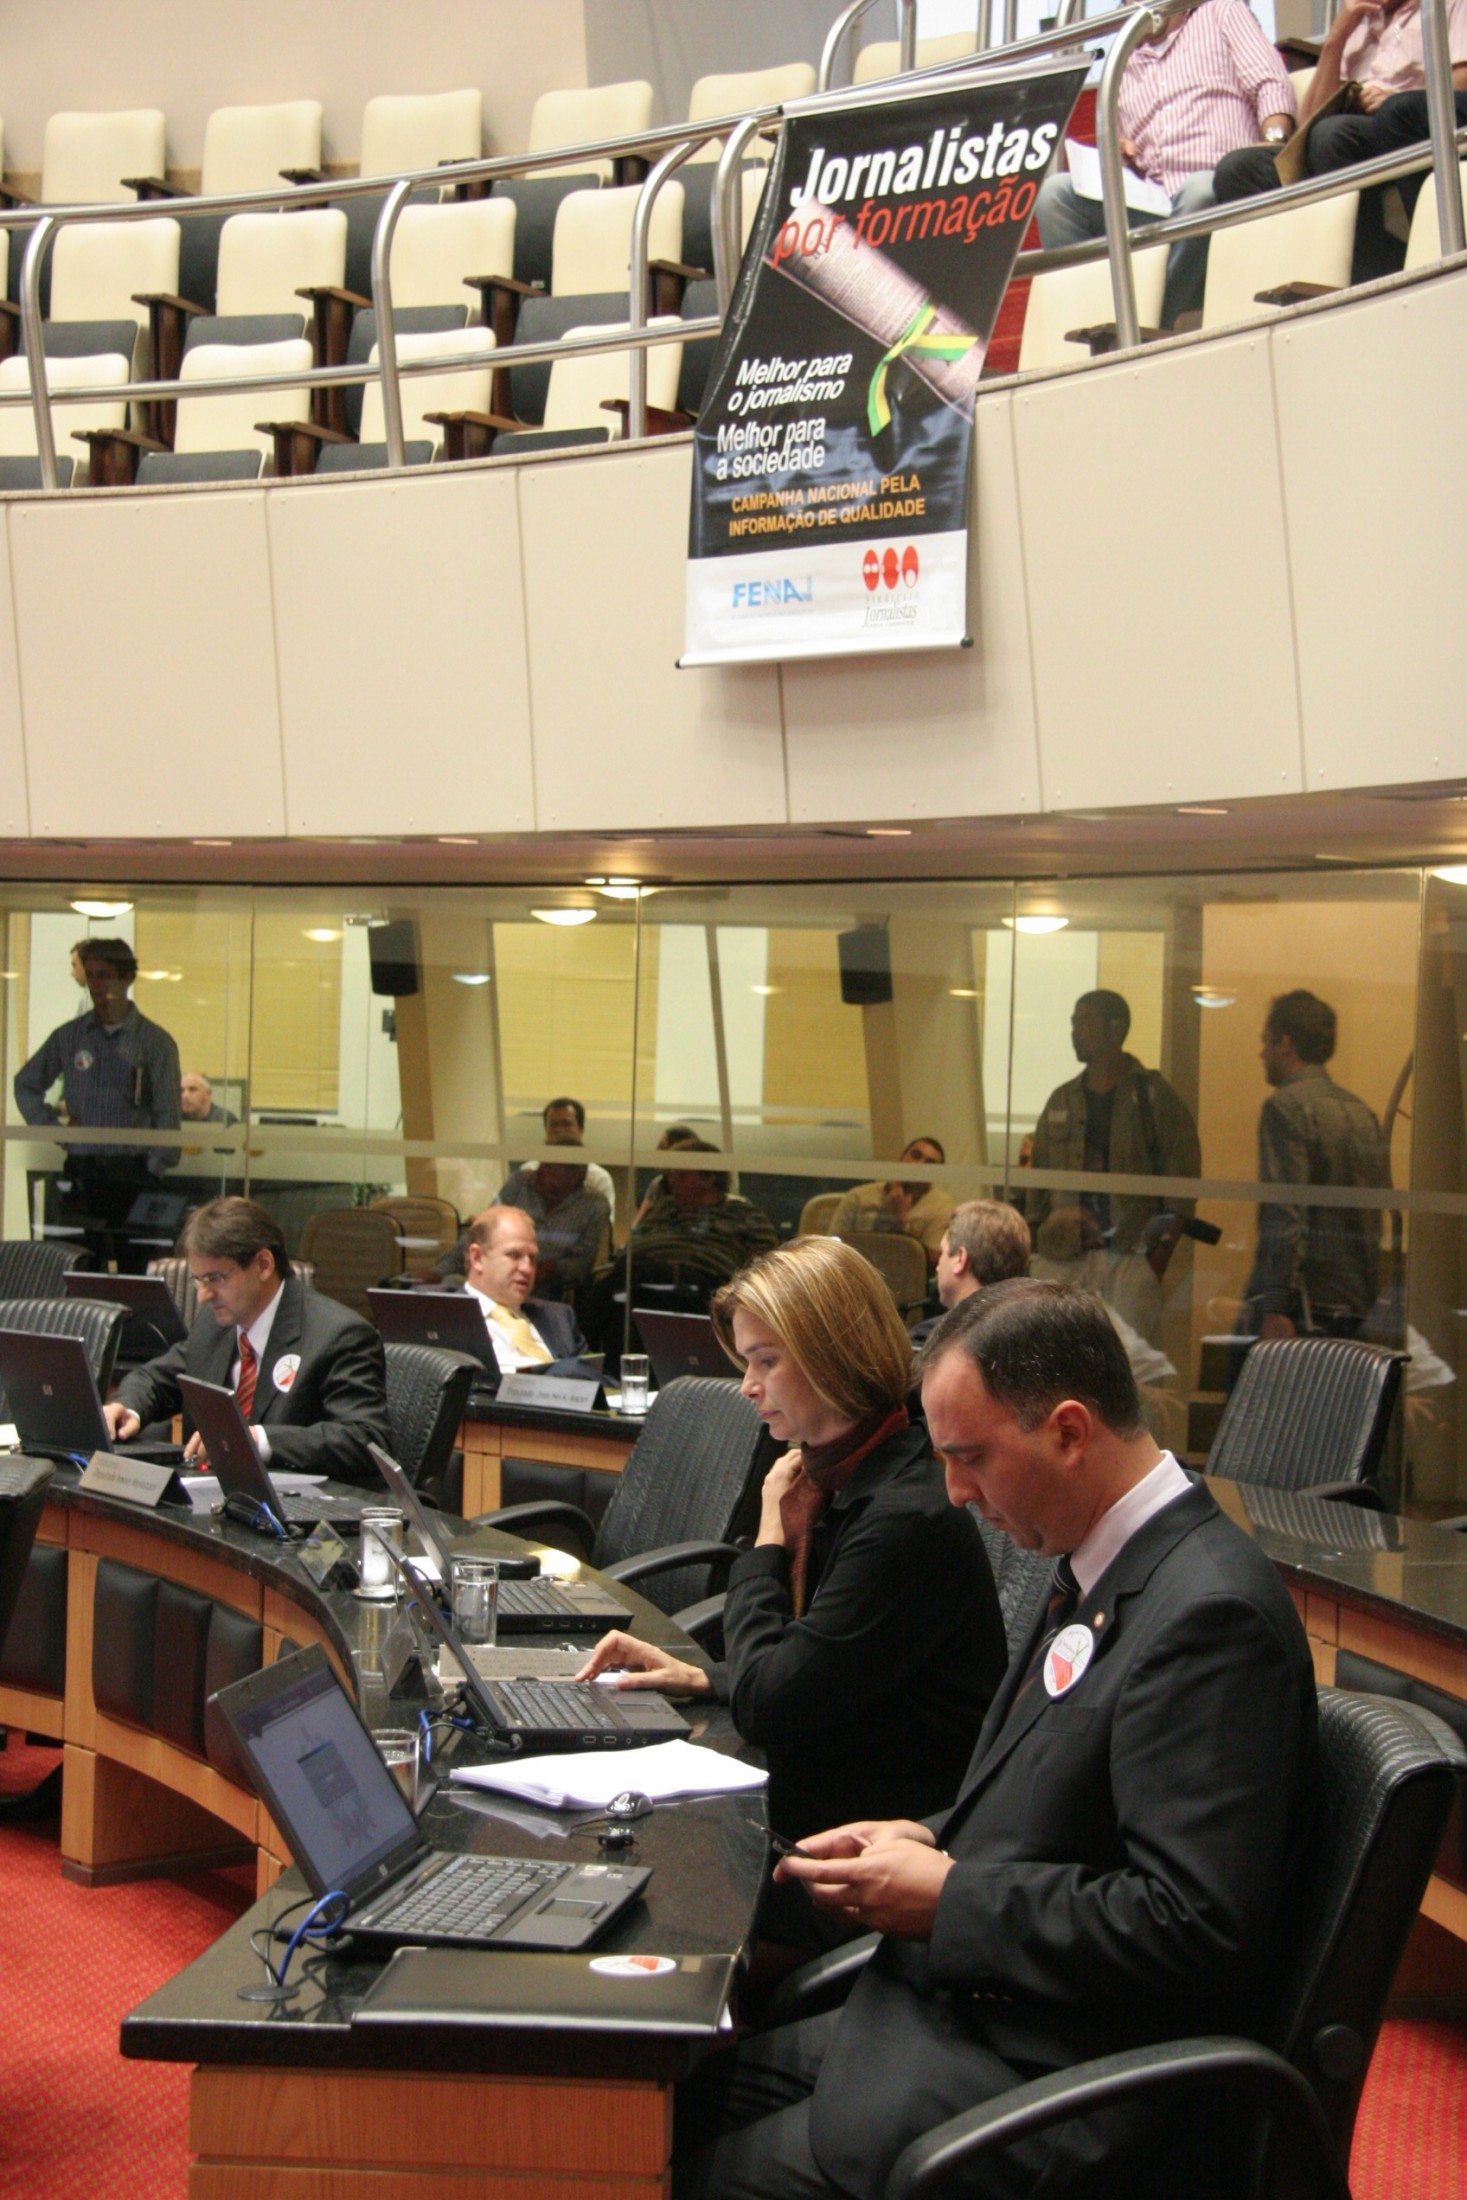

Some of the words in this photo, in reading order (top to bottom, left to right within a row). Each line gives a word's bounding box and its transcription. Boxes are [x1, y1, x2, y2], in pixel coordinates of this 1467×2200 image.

[790, 122, 1058, 208] Jornalistas
[771, 214, 846, 270] por
[854, 176, 1038, 249] formação
[736, 357, 807, 385] Melhor
[803, 354, 853, 388] para
[728, 392, 743, 411] o
[741, 376, 845, 415] jornalismo
[717, 423, 782, 453] Melhor
[785, 417, 826, 450] para
[716, 464, 728, 481] a
[732, 445, 826, 478] sociedade
[731, 489, 804, 513] CAMPANHA
[807, 482, 876, 504] NACIONAL
[880, 474, 921, 494] PELA
[729, 511, 816, 537] INFORMAÇÃO
[818, 506, 838, 526] DE
[840, 498, 926, 523] QUALIDADE
[732, 576, 813, 607] FENAJ
